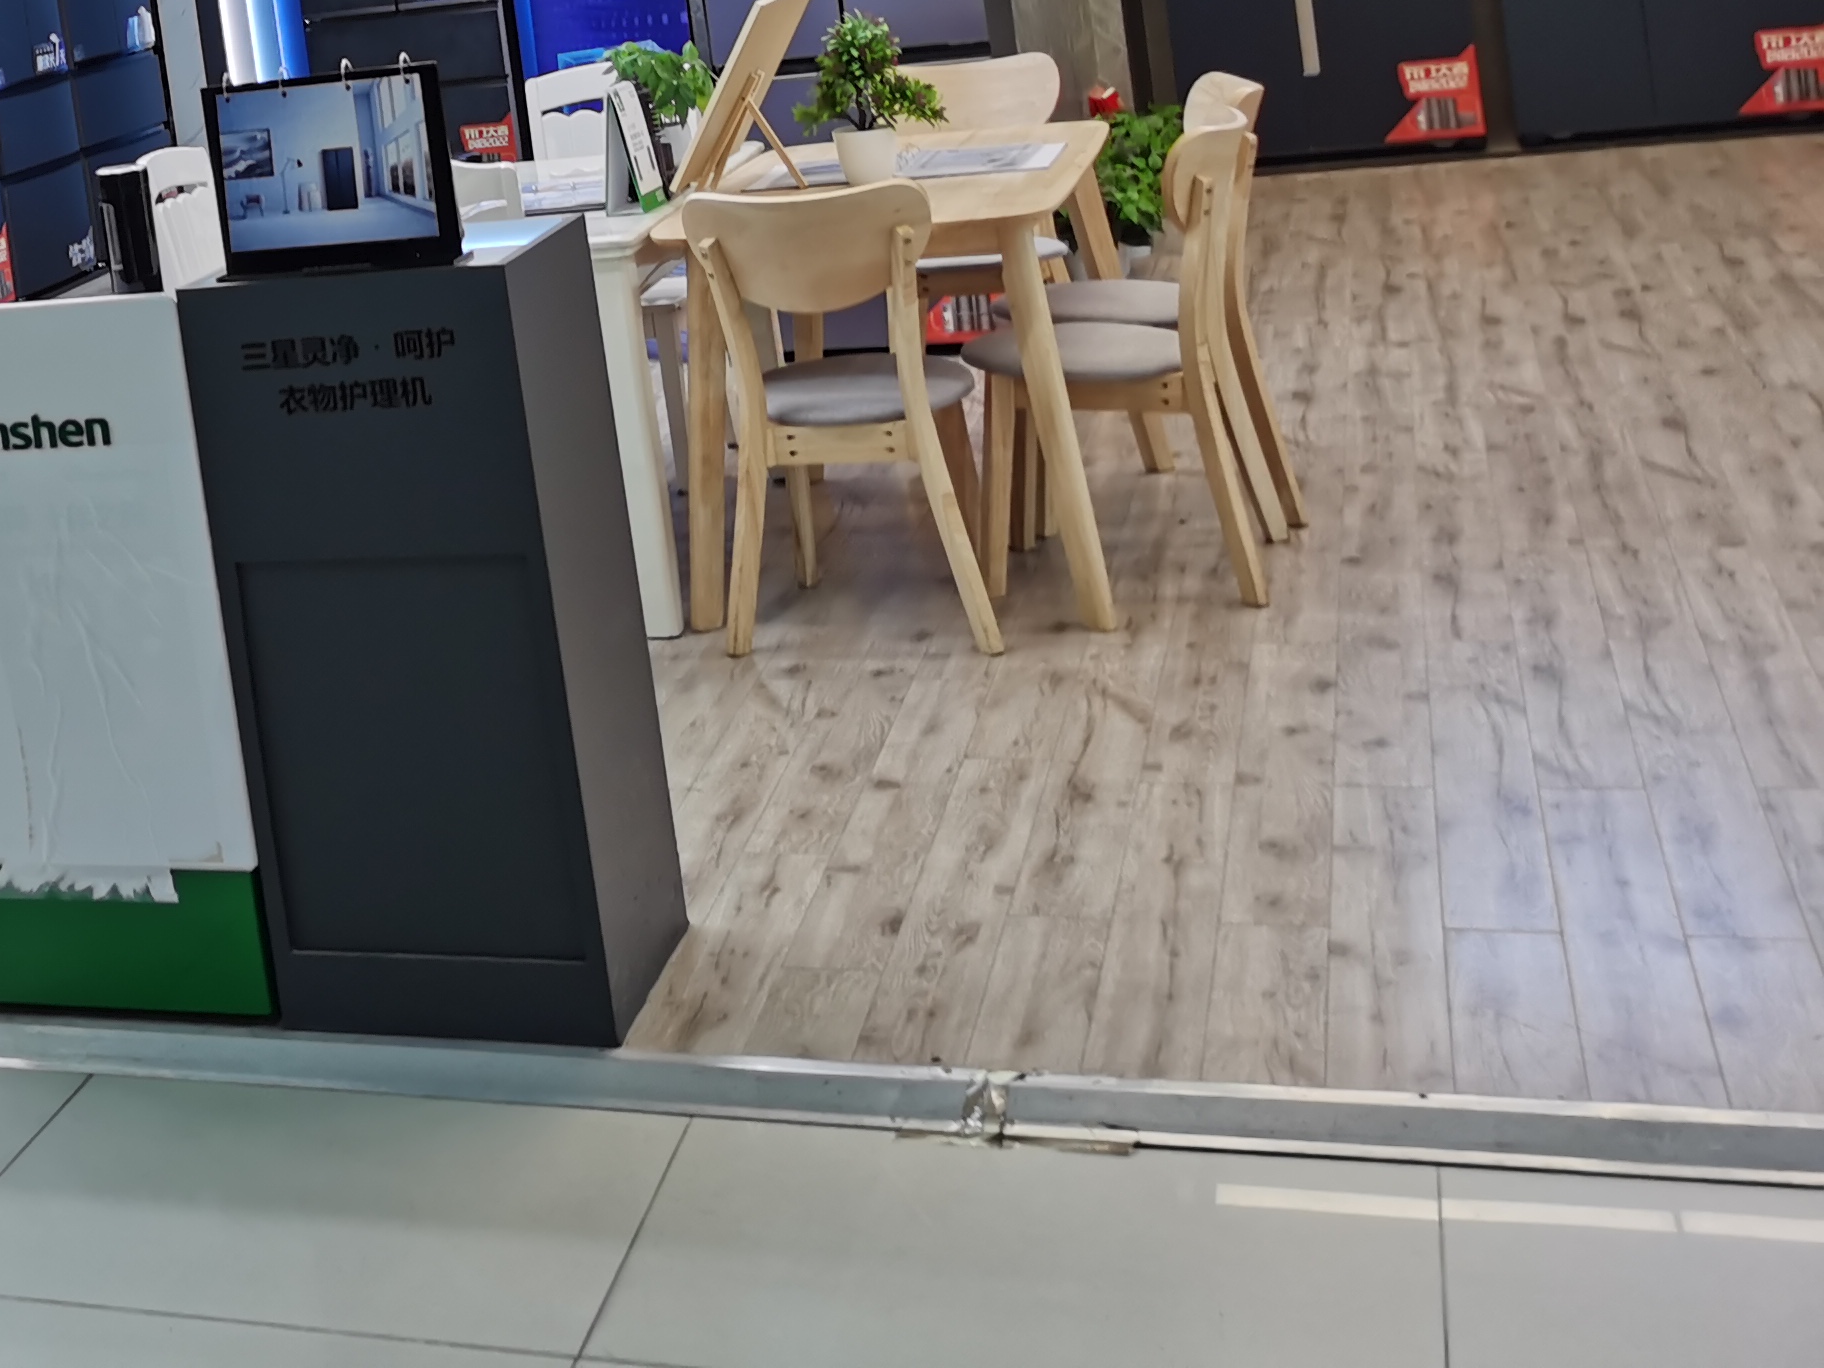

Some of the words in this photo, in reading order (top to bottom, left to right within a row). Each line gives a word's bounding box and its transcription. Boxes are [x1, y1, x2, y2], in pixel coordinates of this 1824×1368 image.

[278, 375, 432, 416] 衣物护理机
